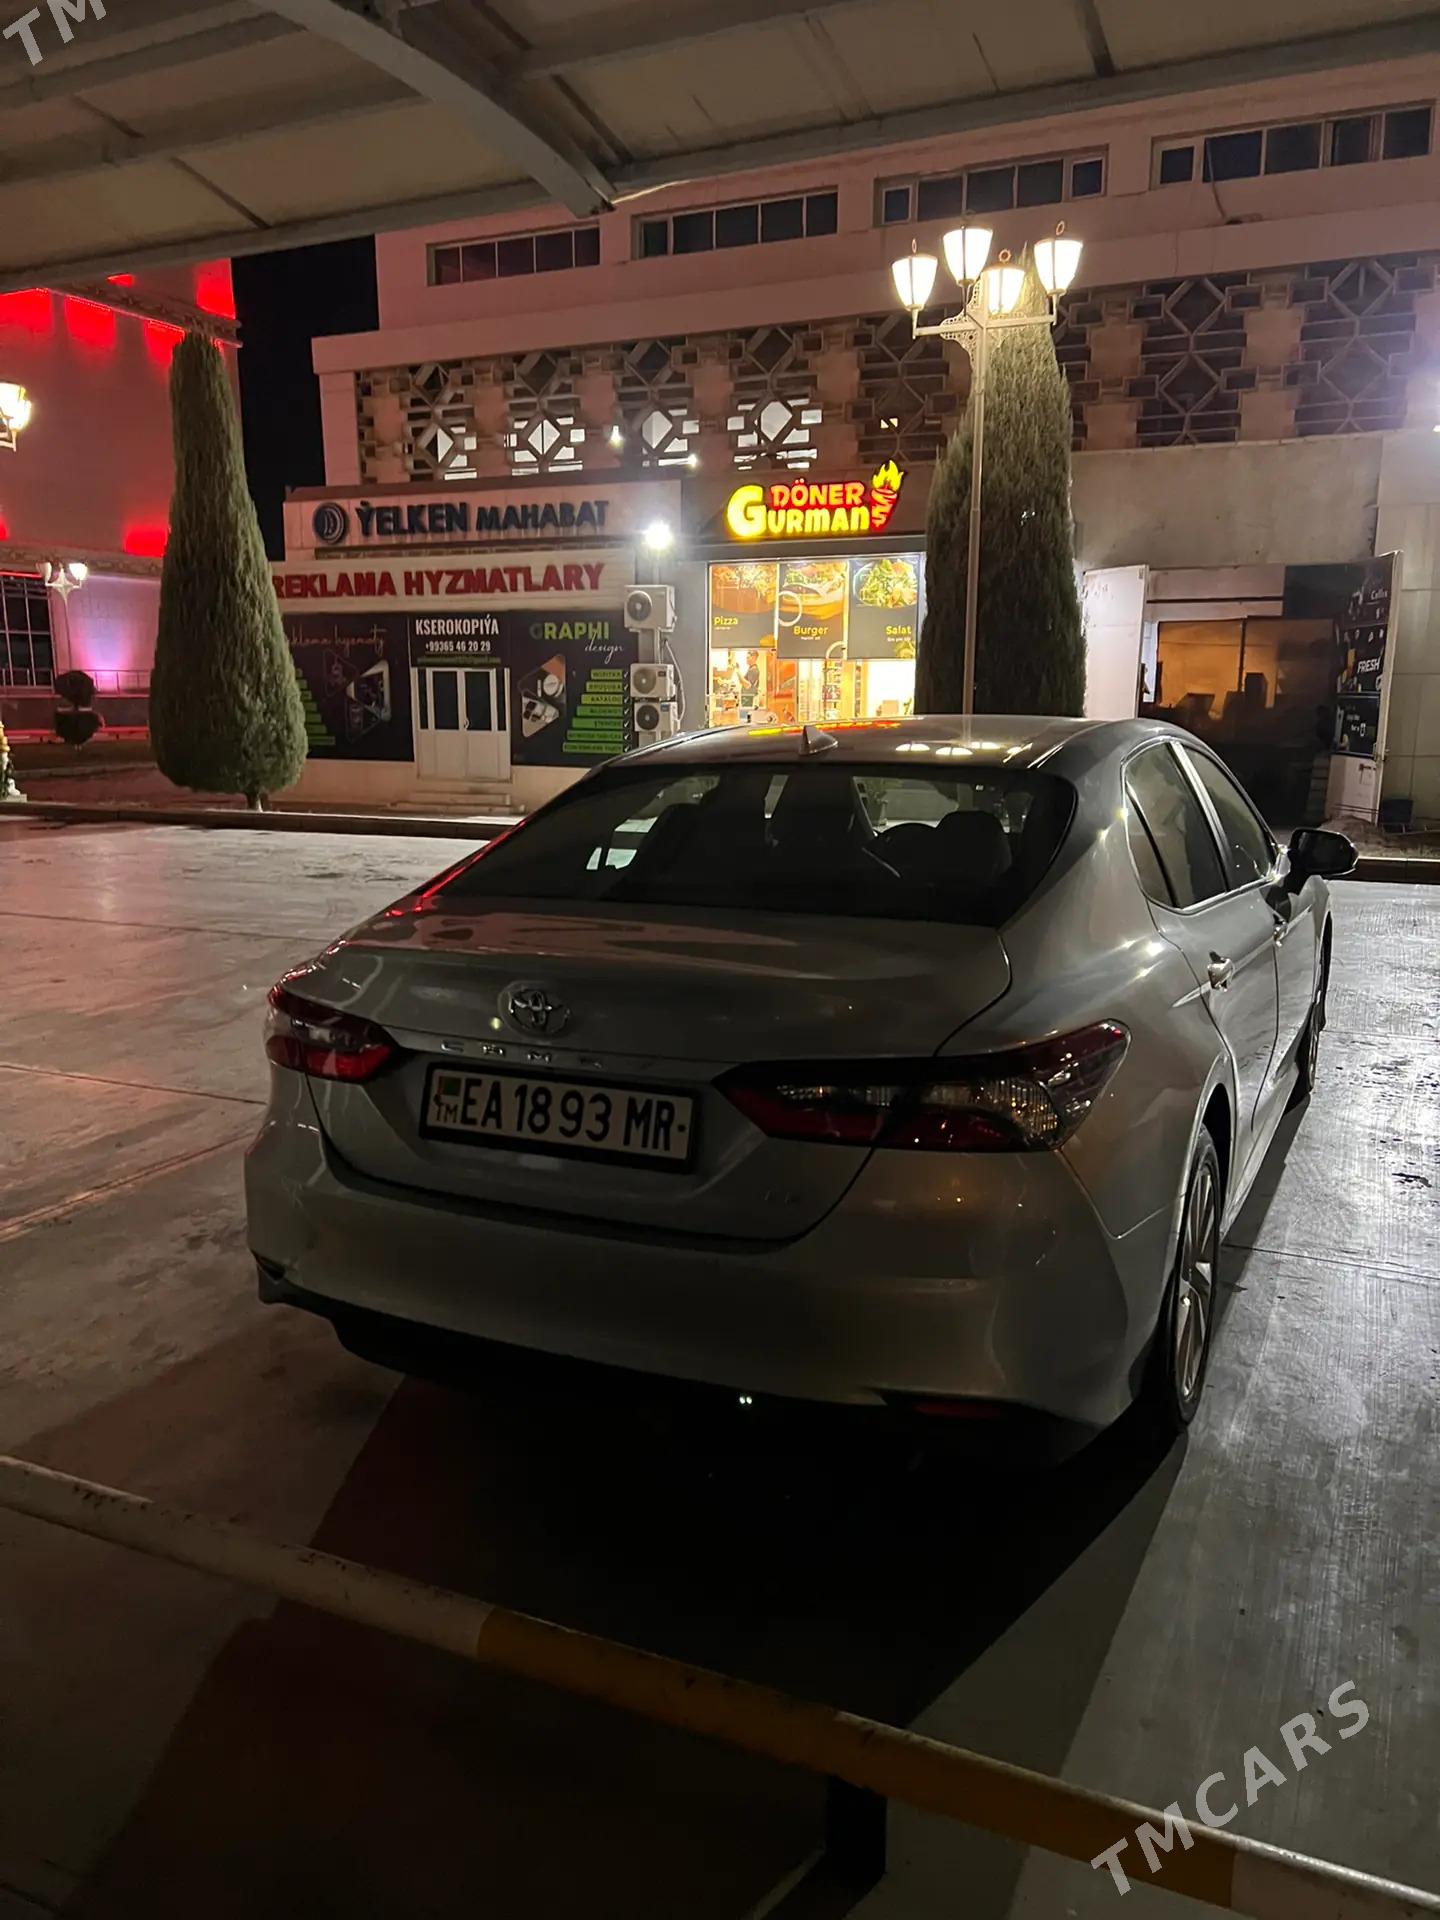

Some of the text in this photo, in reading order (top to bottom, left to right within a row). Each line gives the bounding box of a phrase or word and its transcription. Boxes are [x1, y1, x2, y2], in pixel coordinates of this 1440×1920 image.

[771, 478, 865, 507] DÖNER
[476, 500, 609, 532] MAHABAT
[271, 562, 605, 599] REKLAMA HYZMATLARY
[415, 613, 500, 636] KSEROKOPIÝA
[714, 616, 739, 626] Pizza
[793, 625, 829, 637] Burger
[886, 625, 912, 635] Salat
[1358, 657, 1381, 674] FRESH
[460, 1077, 676, 1151] EA 1893 MR
